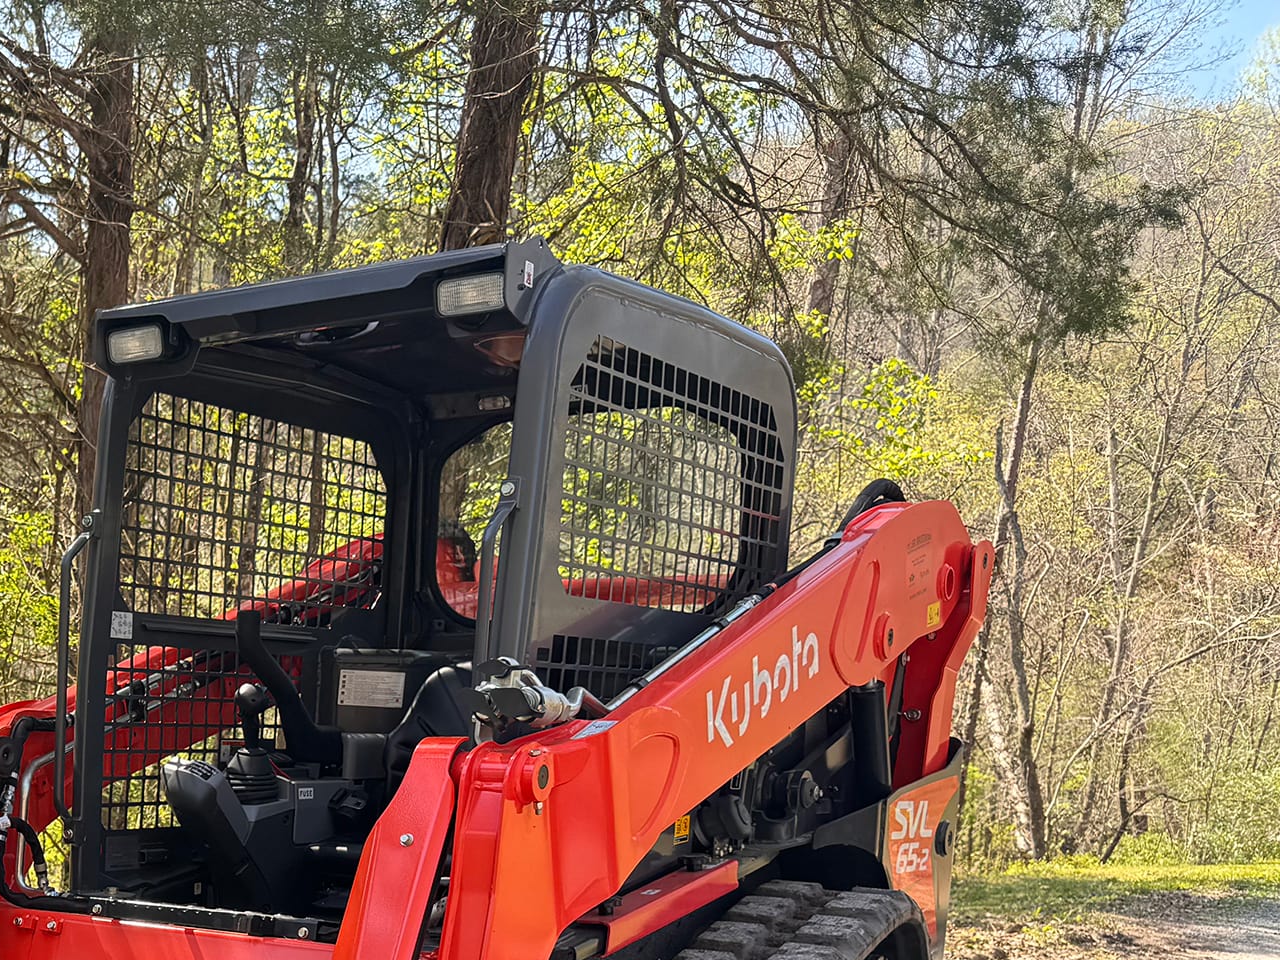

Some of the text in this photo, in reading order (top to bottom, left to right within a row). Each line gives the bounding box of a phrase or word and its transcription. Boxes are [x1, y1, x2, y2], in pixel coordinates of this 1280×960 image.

[706, 625, 819, 748] Kubota
[891, 800, 933, 840] SVL
[896, 842, 929, 874] 65-2
